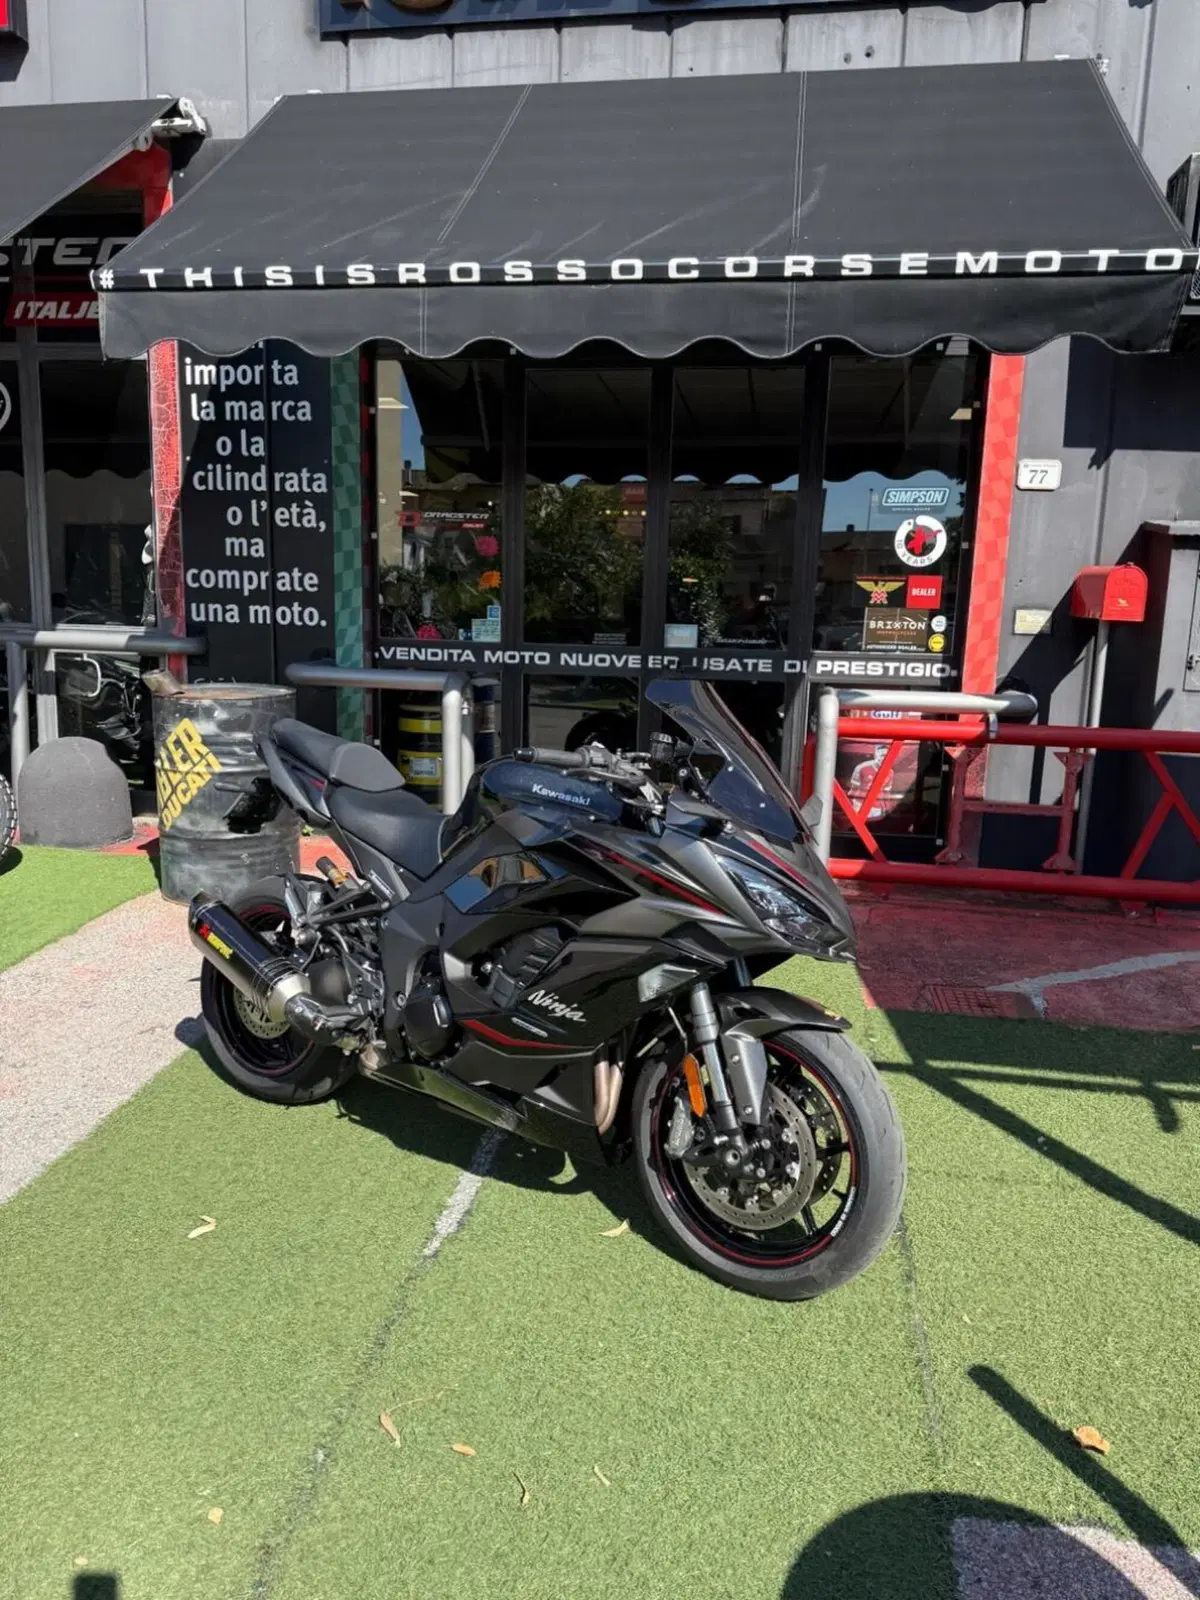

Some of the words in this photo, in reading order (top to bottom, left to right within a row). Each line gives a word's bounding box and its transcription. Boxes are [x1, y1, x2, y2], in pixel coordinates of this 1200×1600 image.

[185, 358, 299, 391] importa
[190, 393, 216, 421] la
[225, 400, 312, 422] marca
[216, 436, 232, 457] o
[240, 429, 265, 457] la
[192, 464, 328, 493] cilindrata
[1029, 470, 1049, 484] 77
[887, 490, 944, 503] SIMPSON
[227, 506, 243, 526] o
[225, 537, 265, 558] ma
[186, 567, 319, 595] comprate
[911, 587, 936, 597] DEALER
[190, 603, 240, 625] una
[249, 604, 327, 627] moto.
[869, 620, 925, 630] BRIXTON
[484, 650, 551, 665] MOTO
[559, 652, 642, 668] NUOVE
[784, 660, 807, 673] DI
[161, 751, 224, 832] DUCATI
[532, 783, 591, 806] Kawasaki
[528, 989, 587, 1022] Ninja
